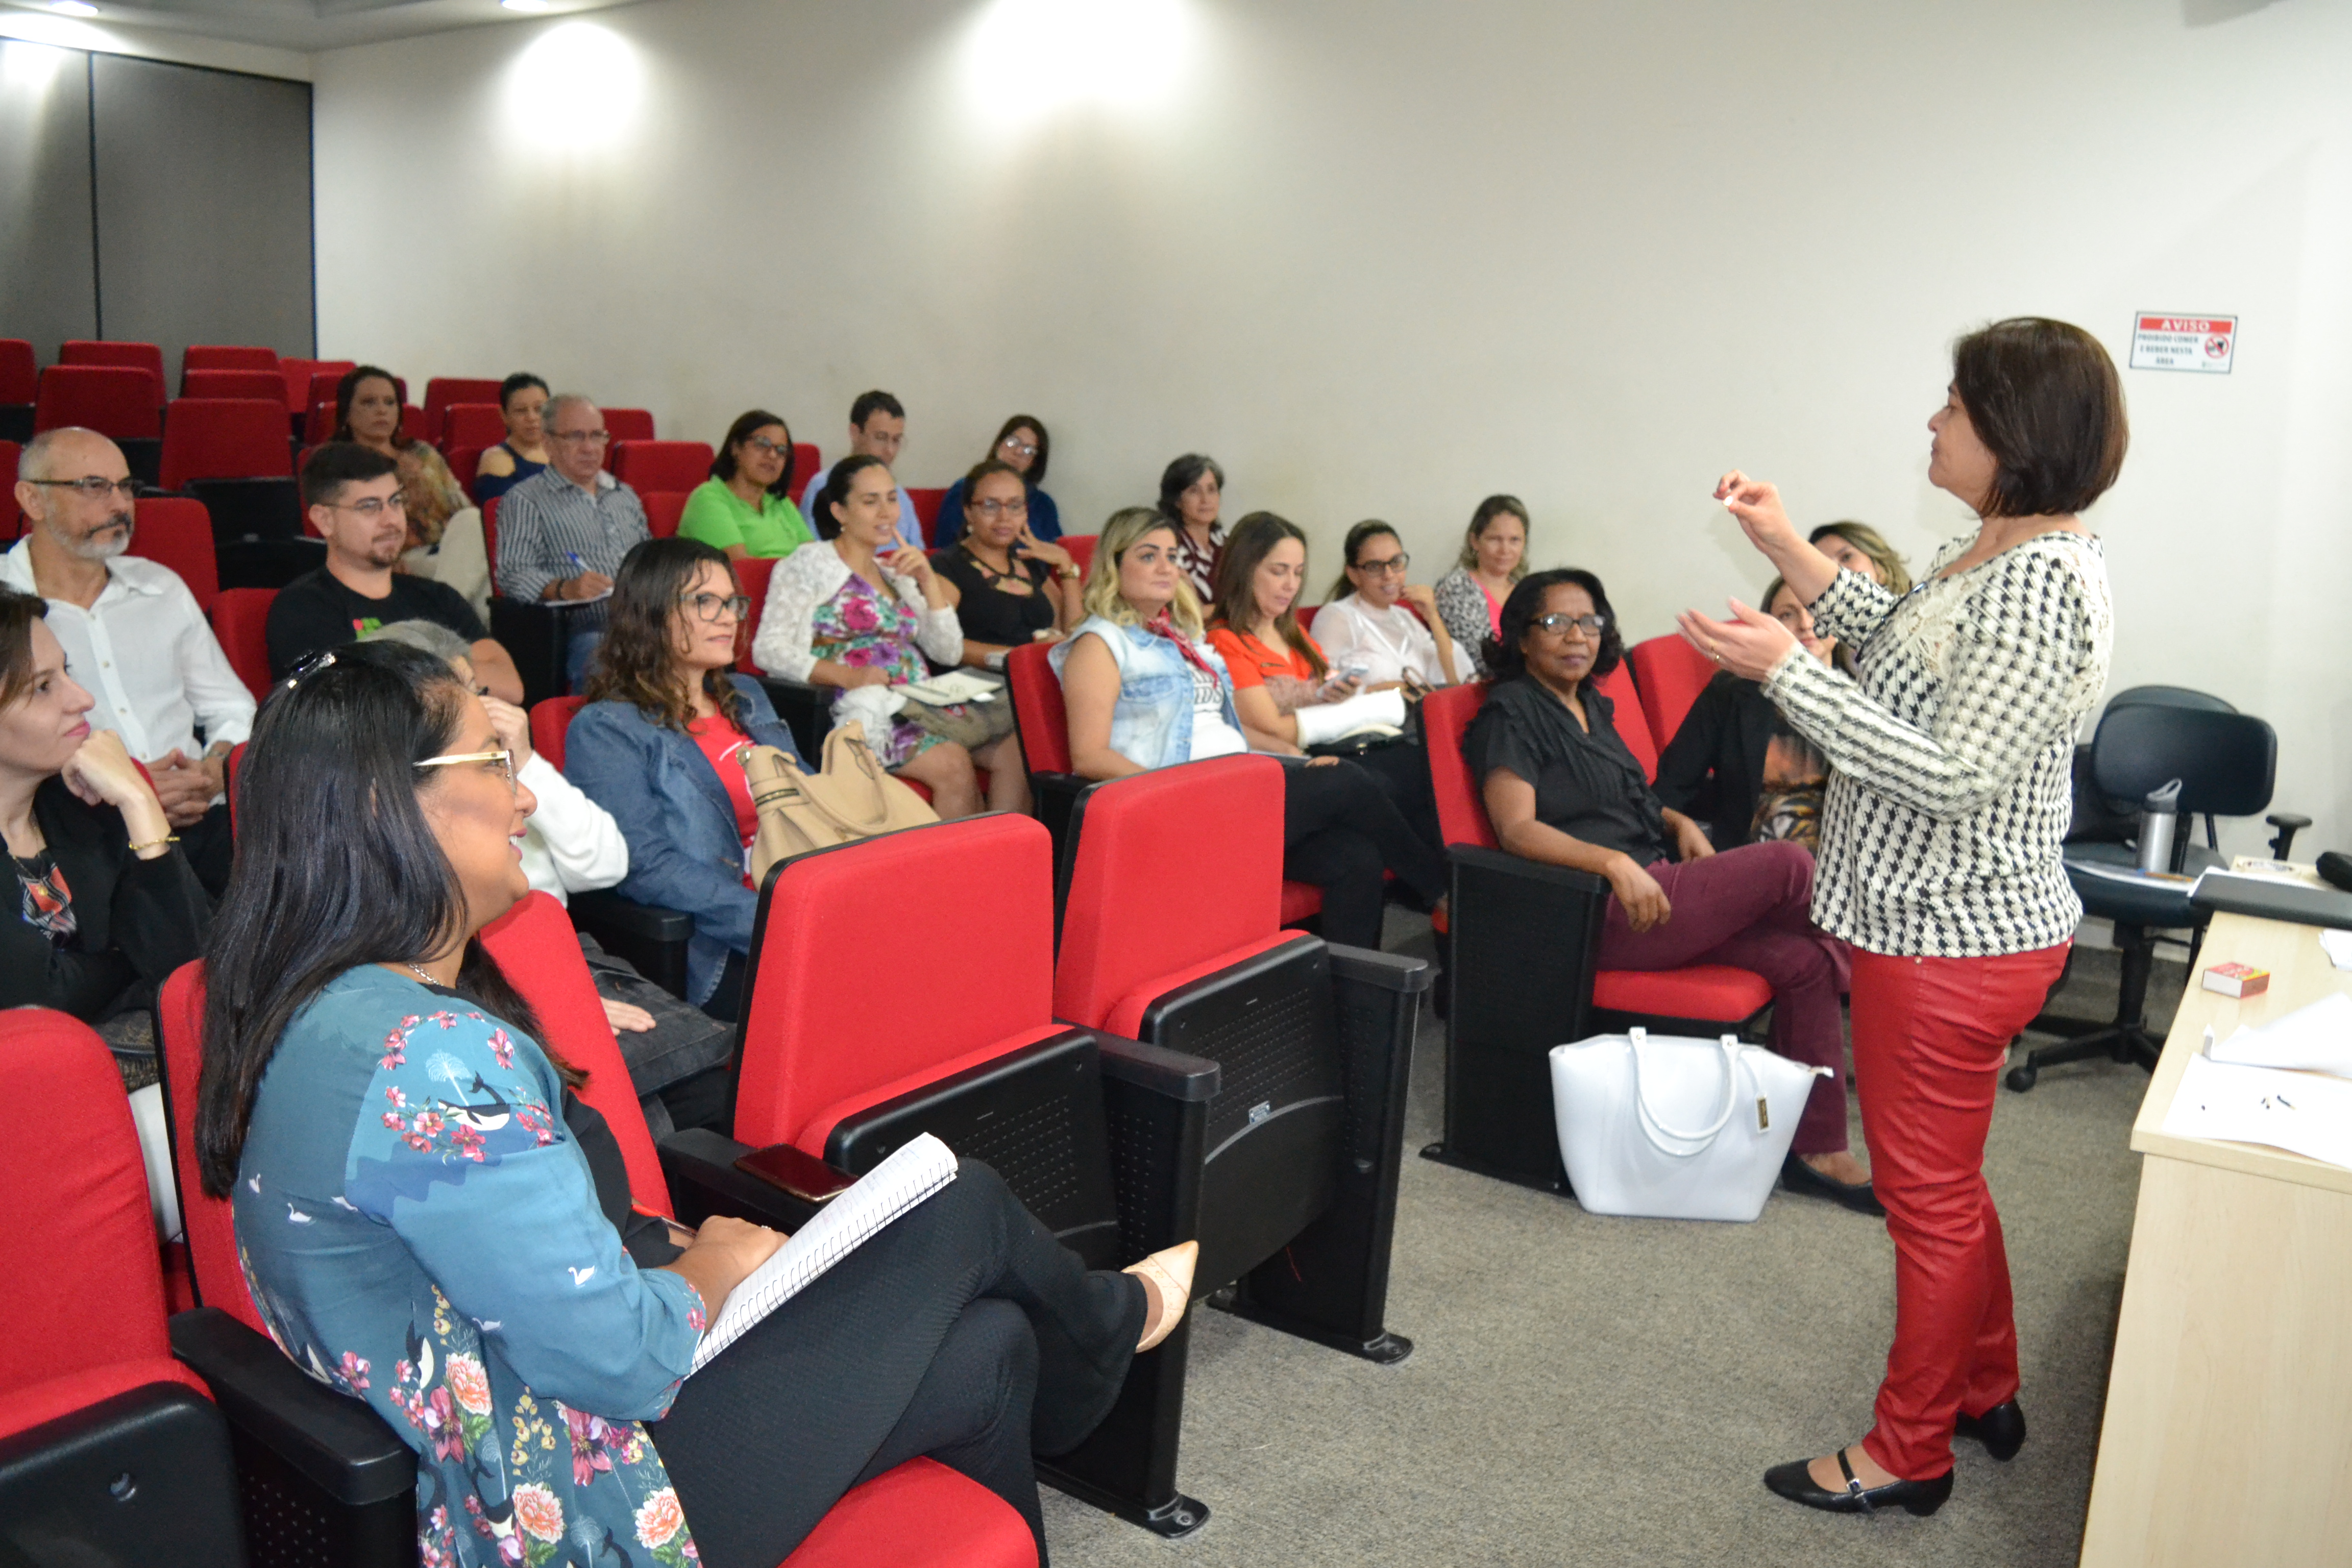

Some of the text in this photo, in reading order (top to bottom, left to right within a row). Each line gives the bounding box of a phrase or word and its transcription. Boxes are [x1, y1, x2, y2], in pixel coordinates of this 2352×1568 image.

[2161, 319, 2210, 332] AVISO
[2138, 333, 2198, 344] PROIBIDO COMER
